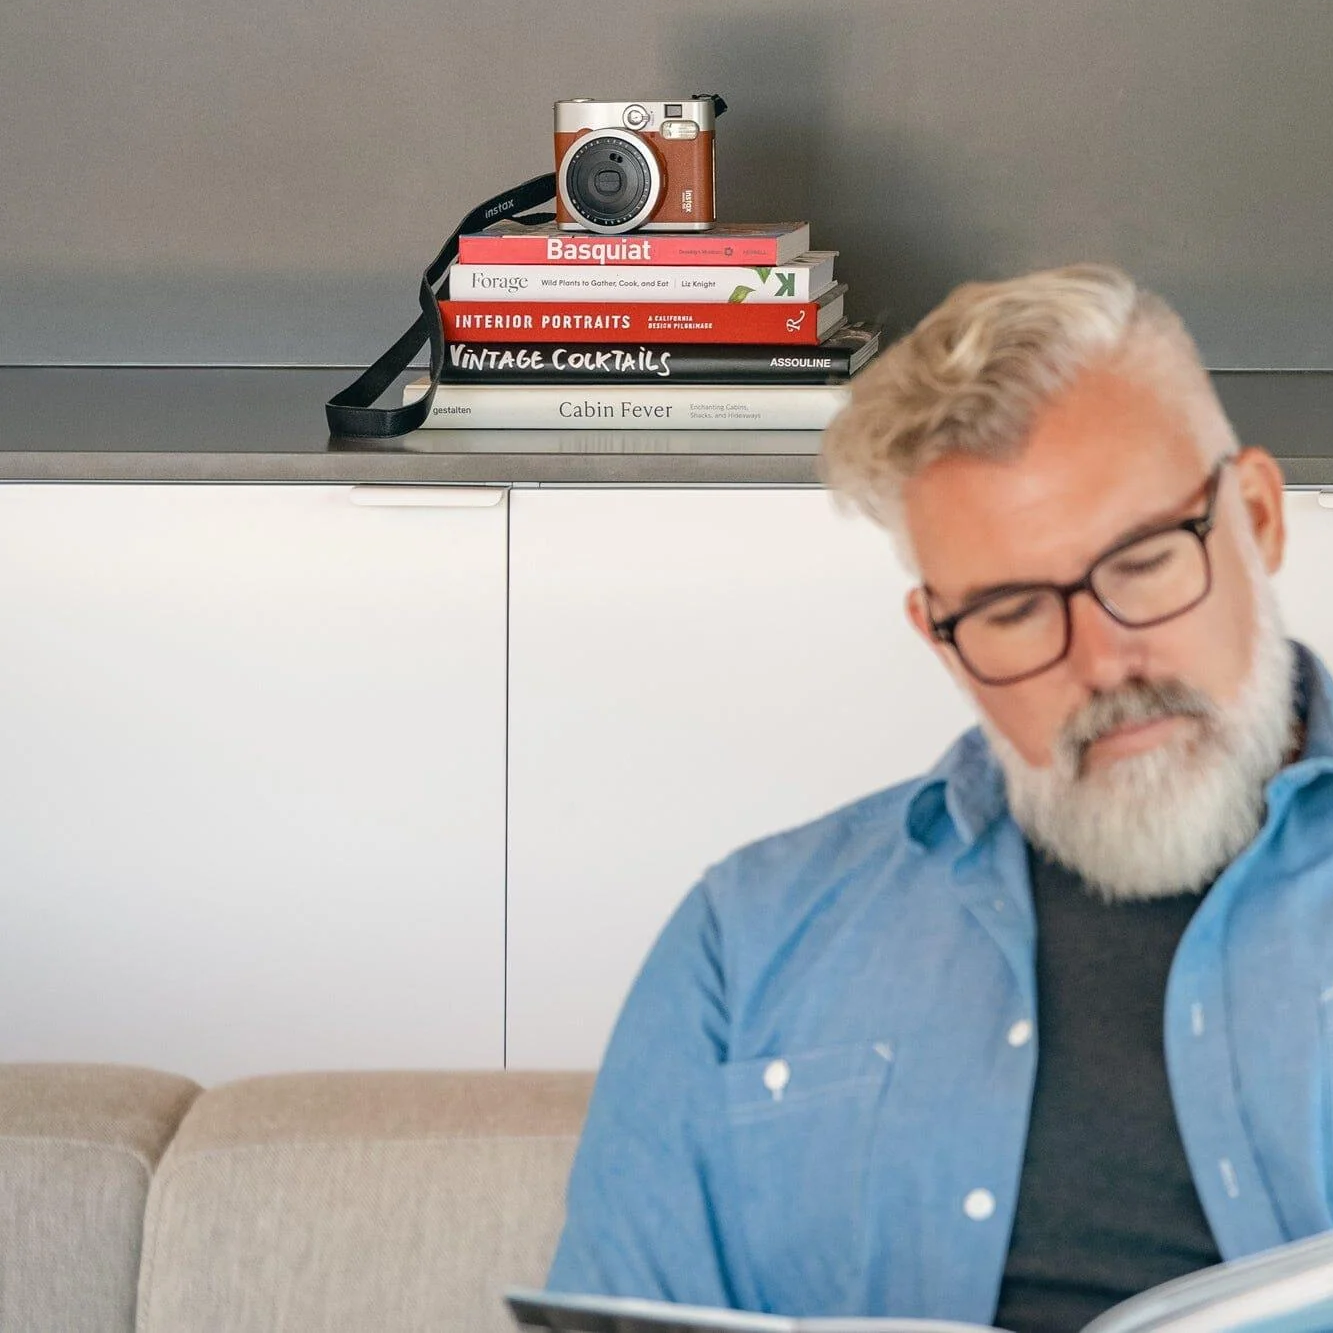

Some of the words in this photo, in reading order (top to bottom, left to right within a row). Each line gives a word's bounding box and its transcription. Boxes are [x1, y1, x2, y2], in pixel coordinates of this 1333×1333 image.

[484, 197, 515, 220] instax
[546, 239, 651, 265] Basquiat
[471, 272, 528, 293] Forage
[541, 279, 557, 287] Wild
[559, 279, 580, 287] Plants
[582, 279, 590, 287] to
[591, 279, 617, 289] Gather,
[619, 279, 640, 289] Cook,
[640, 279, 656, 287] and
[658, 279, 669, 287] Eat
[681, 279, 692, 287] Liz
[693, 279, 716, 290] Knight
[455, 314, 533, 329] INTERIOR
[541, 314, 631, 329] PORTRAITS
[770, 358, 831, 368] ASSOULINE
[432, 405, 472, 416] gestalten
[559, 401, 615, 418] Cabin
[621, 401, 673, 418] Fever
